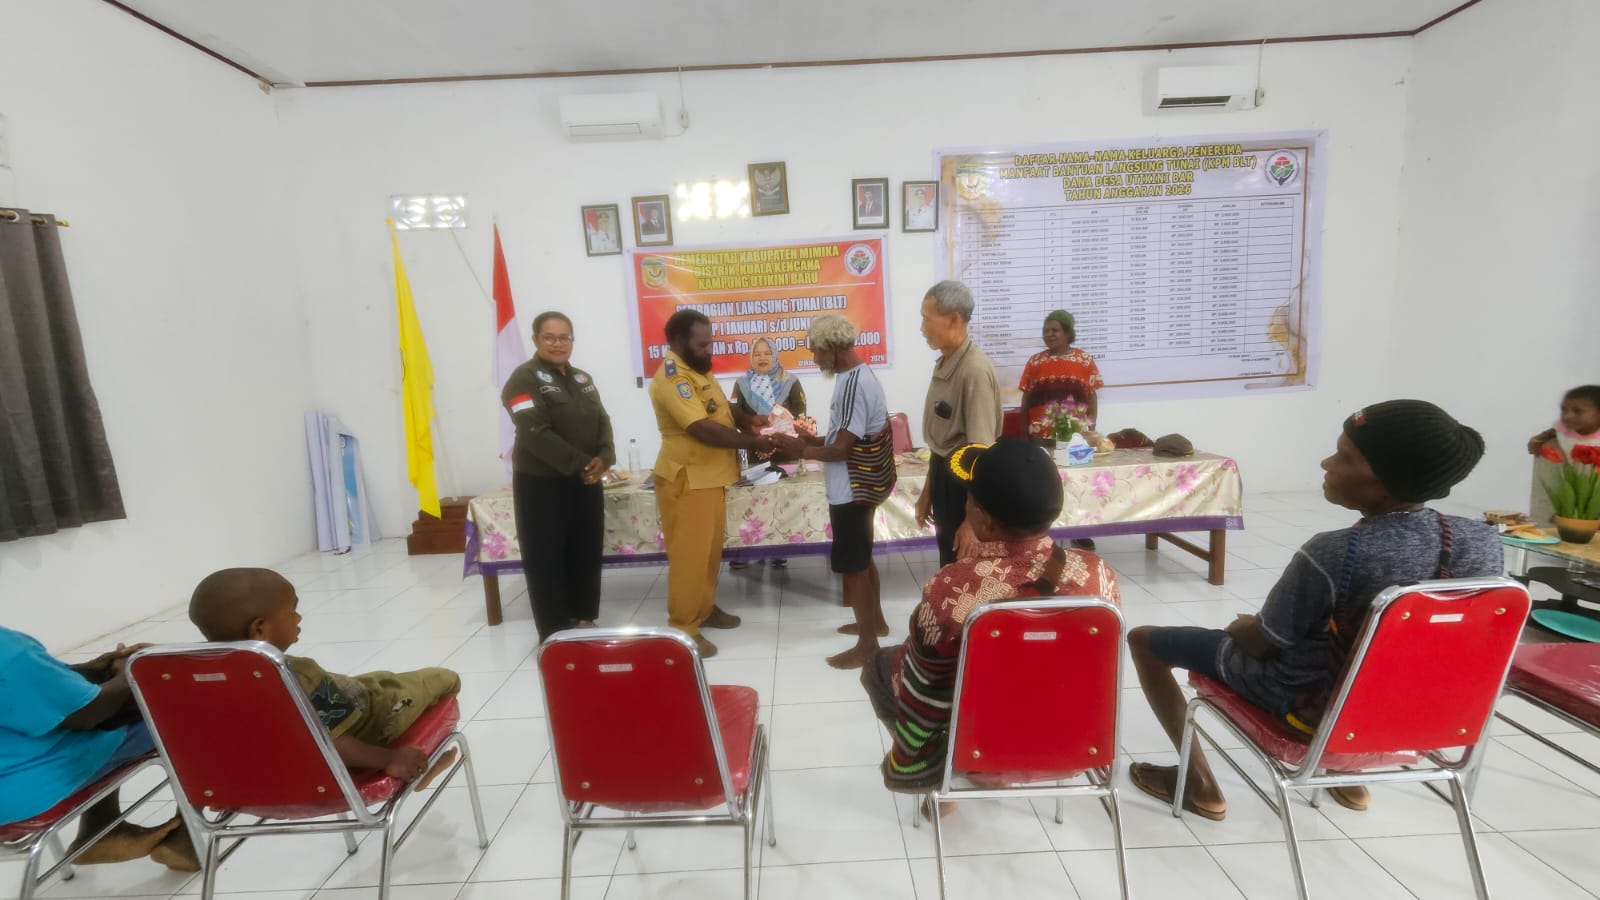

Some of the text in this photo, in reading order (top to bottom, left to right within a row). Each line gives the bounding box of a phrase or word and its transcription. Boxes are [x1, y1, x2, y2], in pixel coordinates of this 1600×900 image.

[1014, 144, 1242, 166] DAFTAR NAMA-NAMA KELUARGA PENERIMA
[1000, 155, 1257, 179] MANFAAT BANTUAN LANGSUNG TUNAI (KPM BLT)
[1063, 171, 1194, 189] DANA DESA UTIKINI BAR
[1064, 184, 1192, 201] TAHUN ANGGARAN 2026
[800, 245, 839, 259] MIMIKA
[739, 262, 773, 275] KUALA
[774, 259, 820, 273] KENCANA
[698, 276, 749, 289] KAMPUNG
[790, 271, 819, 284] BARU
[735, 299, 789, 316] LANGSUNG
[790, 296, 820, 312] TUNAI
[822, 294, 847, 309] (BLT)
[769, 317, 787, 333] s/d
[647, 344, 660, 359] 15
